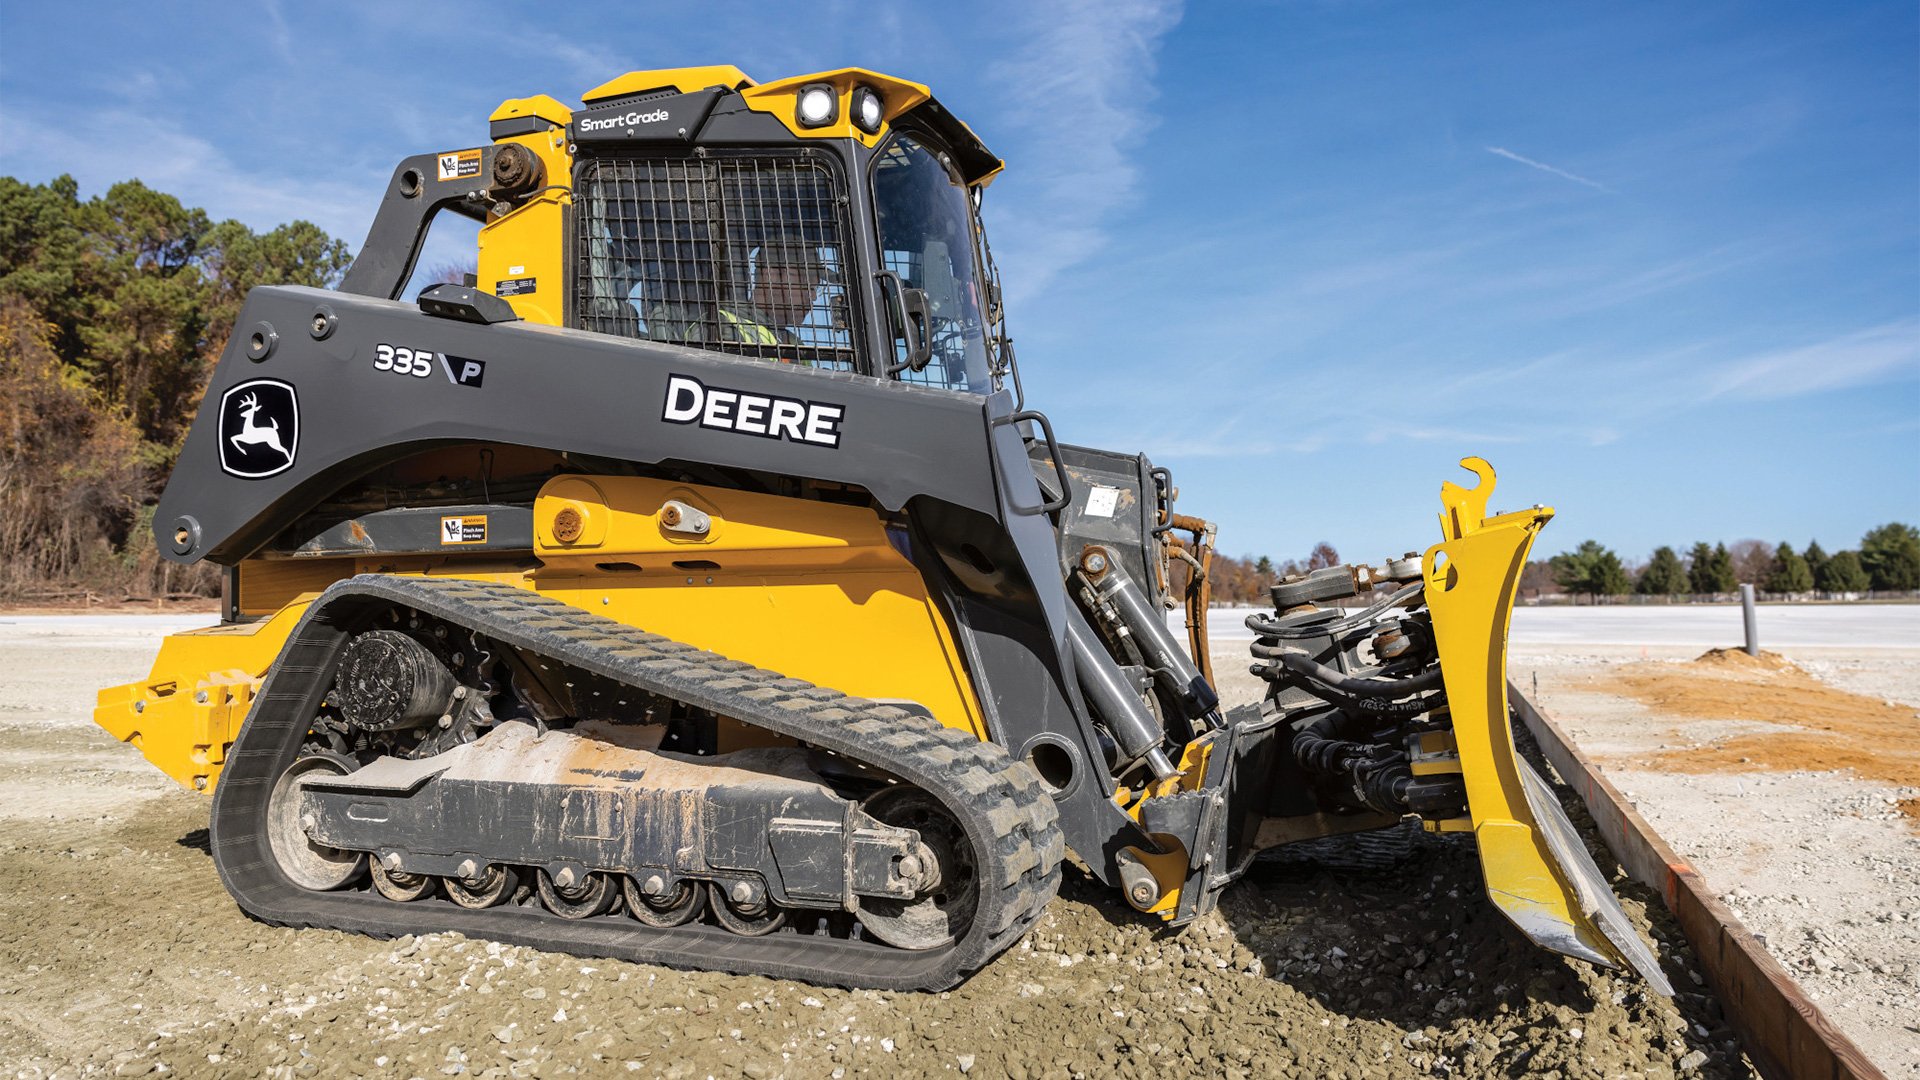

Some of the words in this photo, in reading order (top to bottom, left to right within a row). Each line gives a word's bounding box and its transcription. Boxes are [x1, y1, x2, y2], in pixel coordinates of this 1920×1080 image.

[580, 115, 625, 132] Smart
[625, 108, 669, 126] Grade
[373, 343, 434, 379] 335
[663, 375, 843, 446] DEERE
